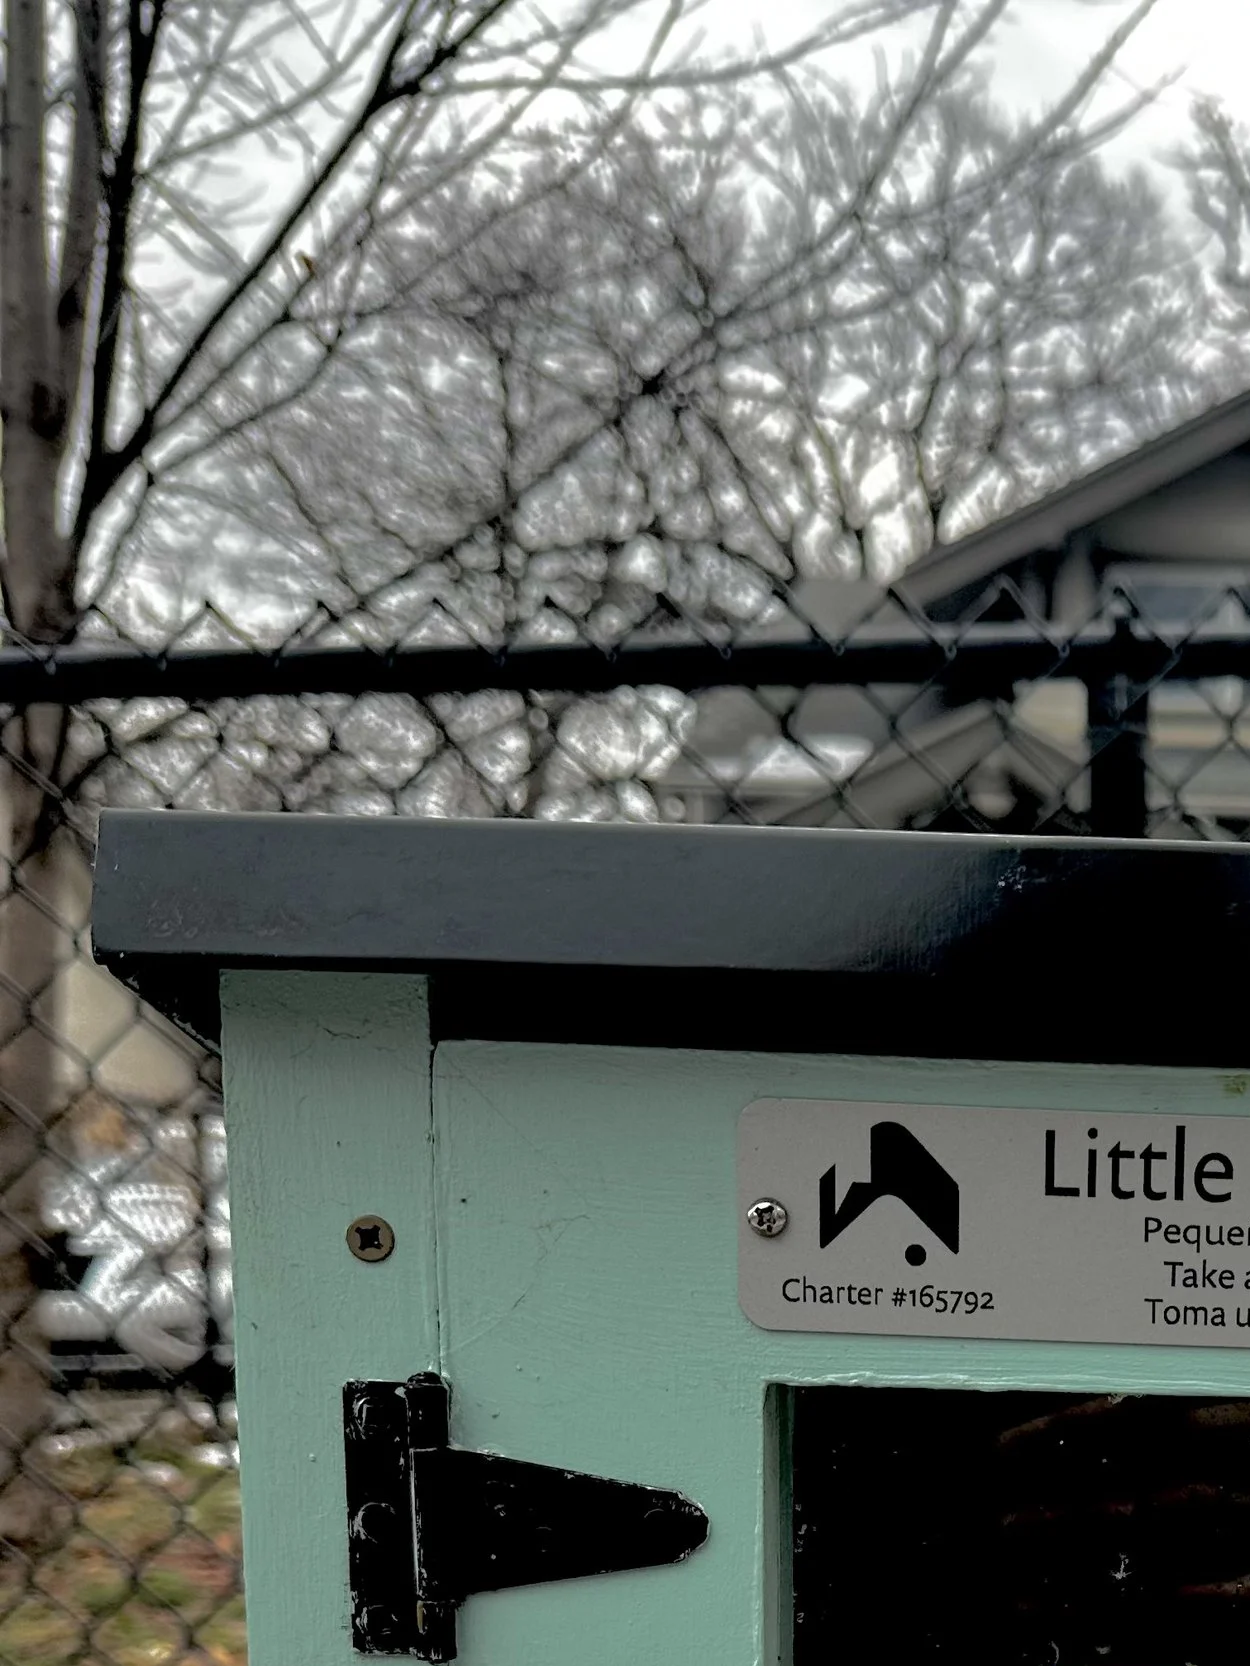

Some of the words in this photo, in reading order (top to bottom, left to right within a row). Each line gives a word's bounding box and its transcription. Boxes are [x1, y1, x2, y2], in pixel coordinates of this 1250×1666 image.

[1045, 1125, 1234, 1203] Little
[1163, 1259, 1235, 1289] Take
[781, 1278, 884, 1309] Charter
[890, 1286, 995, 1318] #165792
[1144, 1298, 1226, 1327] Toma
